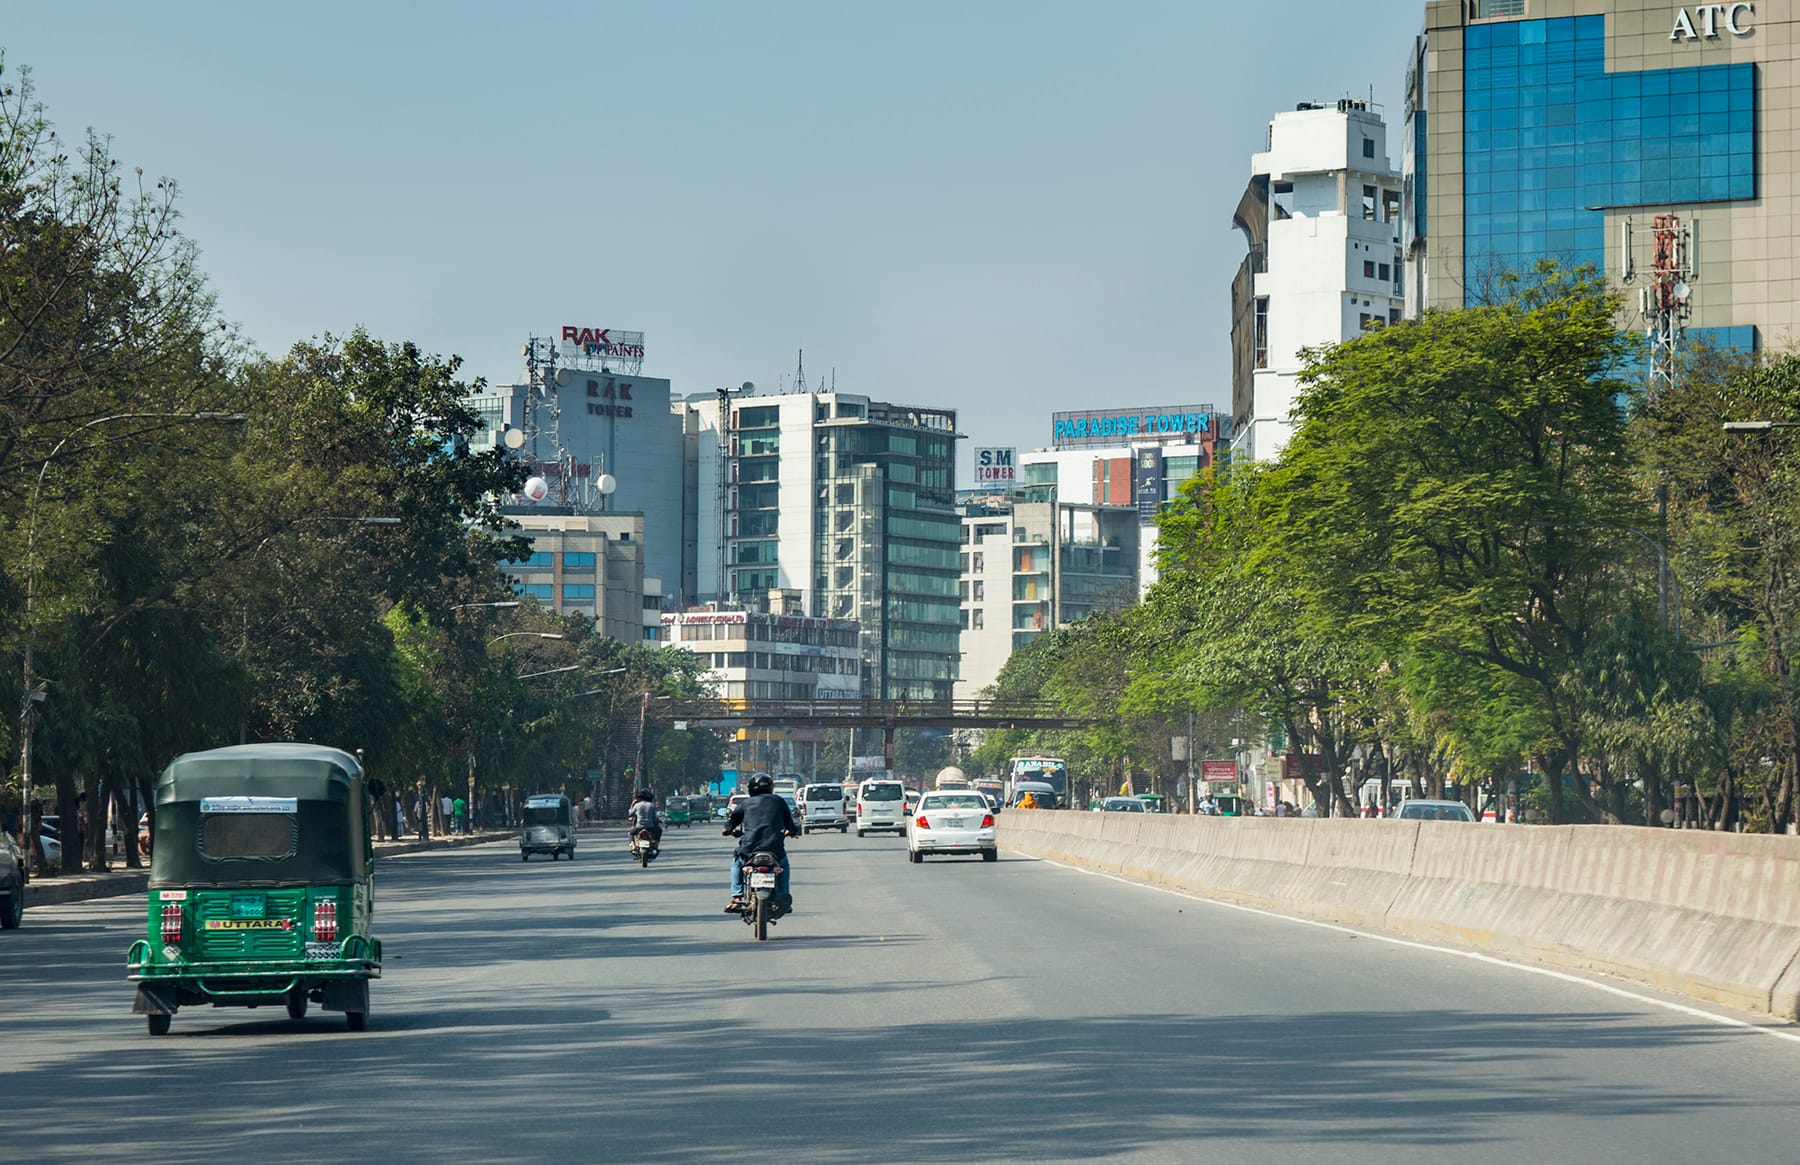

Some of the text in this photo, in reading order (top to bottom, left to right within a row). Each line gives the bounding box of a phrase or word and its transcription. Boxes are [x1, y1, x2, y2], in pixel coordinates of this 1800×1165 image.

[1668, 2, 1754, 40] ATC
[562, 326, 609, 345] RAK
[607, 343, 645, 358] PAINTS
[587, 380, 632, 400] RAK
[587, 402, 632, 418] TOWER
[1055, 413, 1209, 439] PARADISE TOWER
[978, 467, 1014, 480] TOWER
[223, 920, 283, 929] UTTARA
